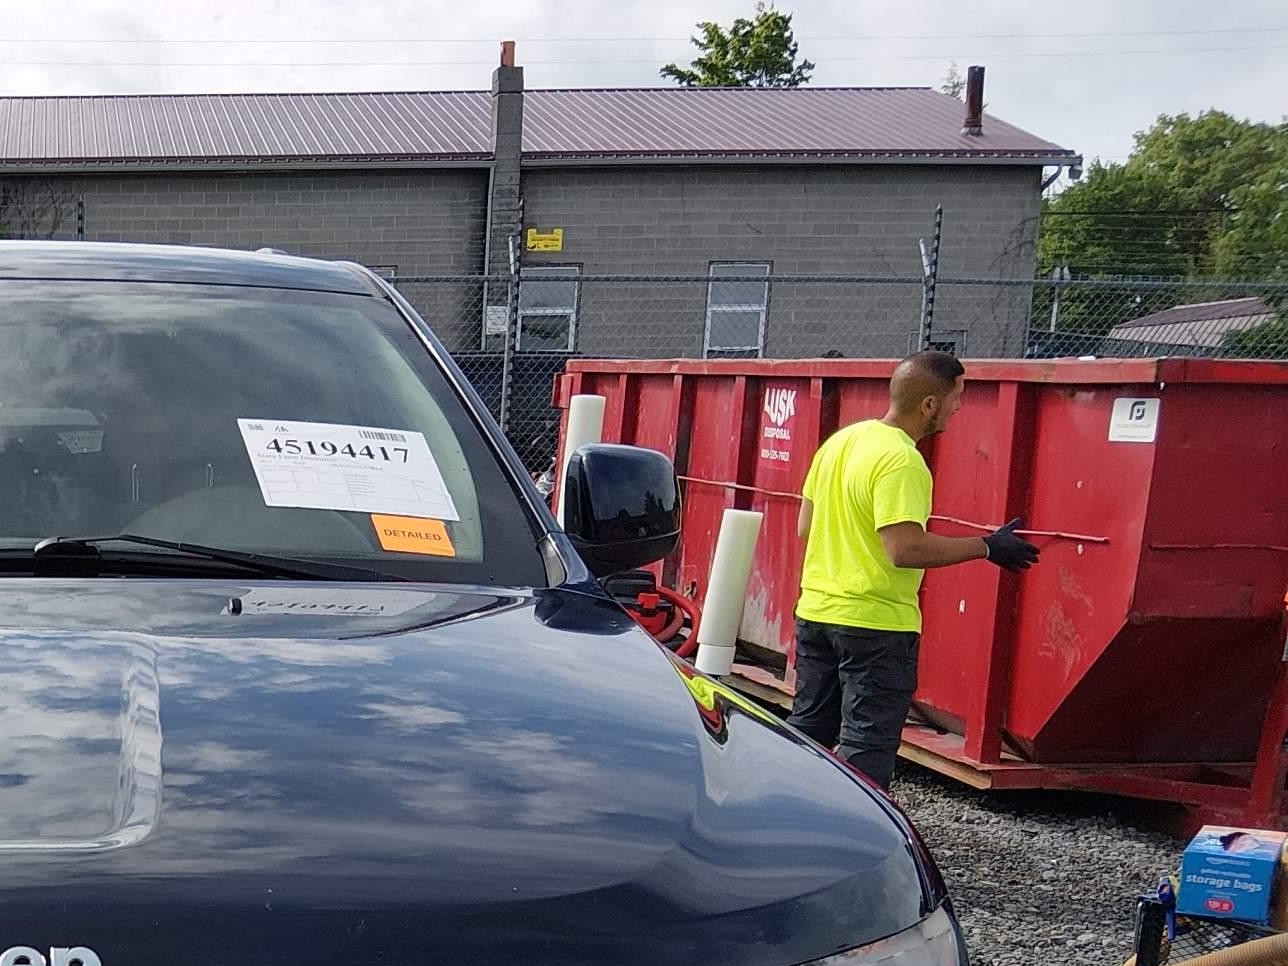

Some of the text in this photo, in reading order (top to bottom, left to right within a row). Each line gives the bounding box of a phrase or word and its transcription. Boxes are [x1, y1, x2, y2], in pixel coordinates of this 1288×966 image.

[764, 387, 797, 427] LUSK
[763, 426, 791, 440] DISPOSAL
[265, 438, 409, 463] 45194417
[383, 528, 442, 542] DETAILED
[1185, 874, 1262, 893] storage bags
